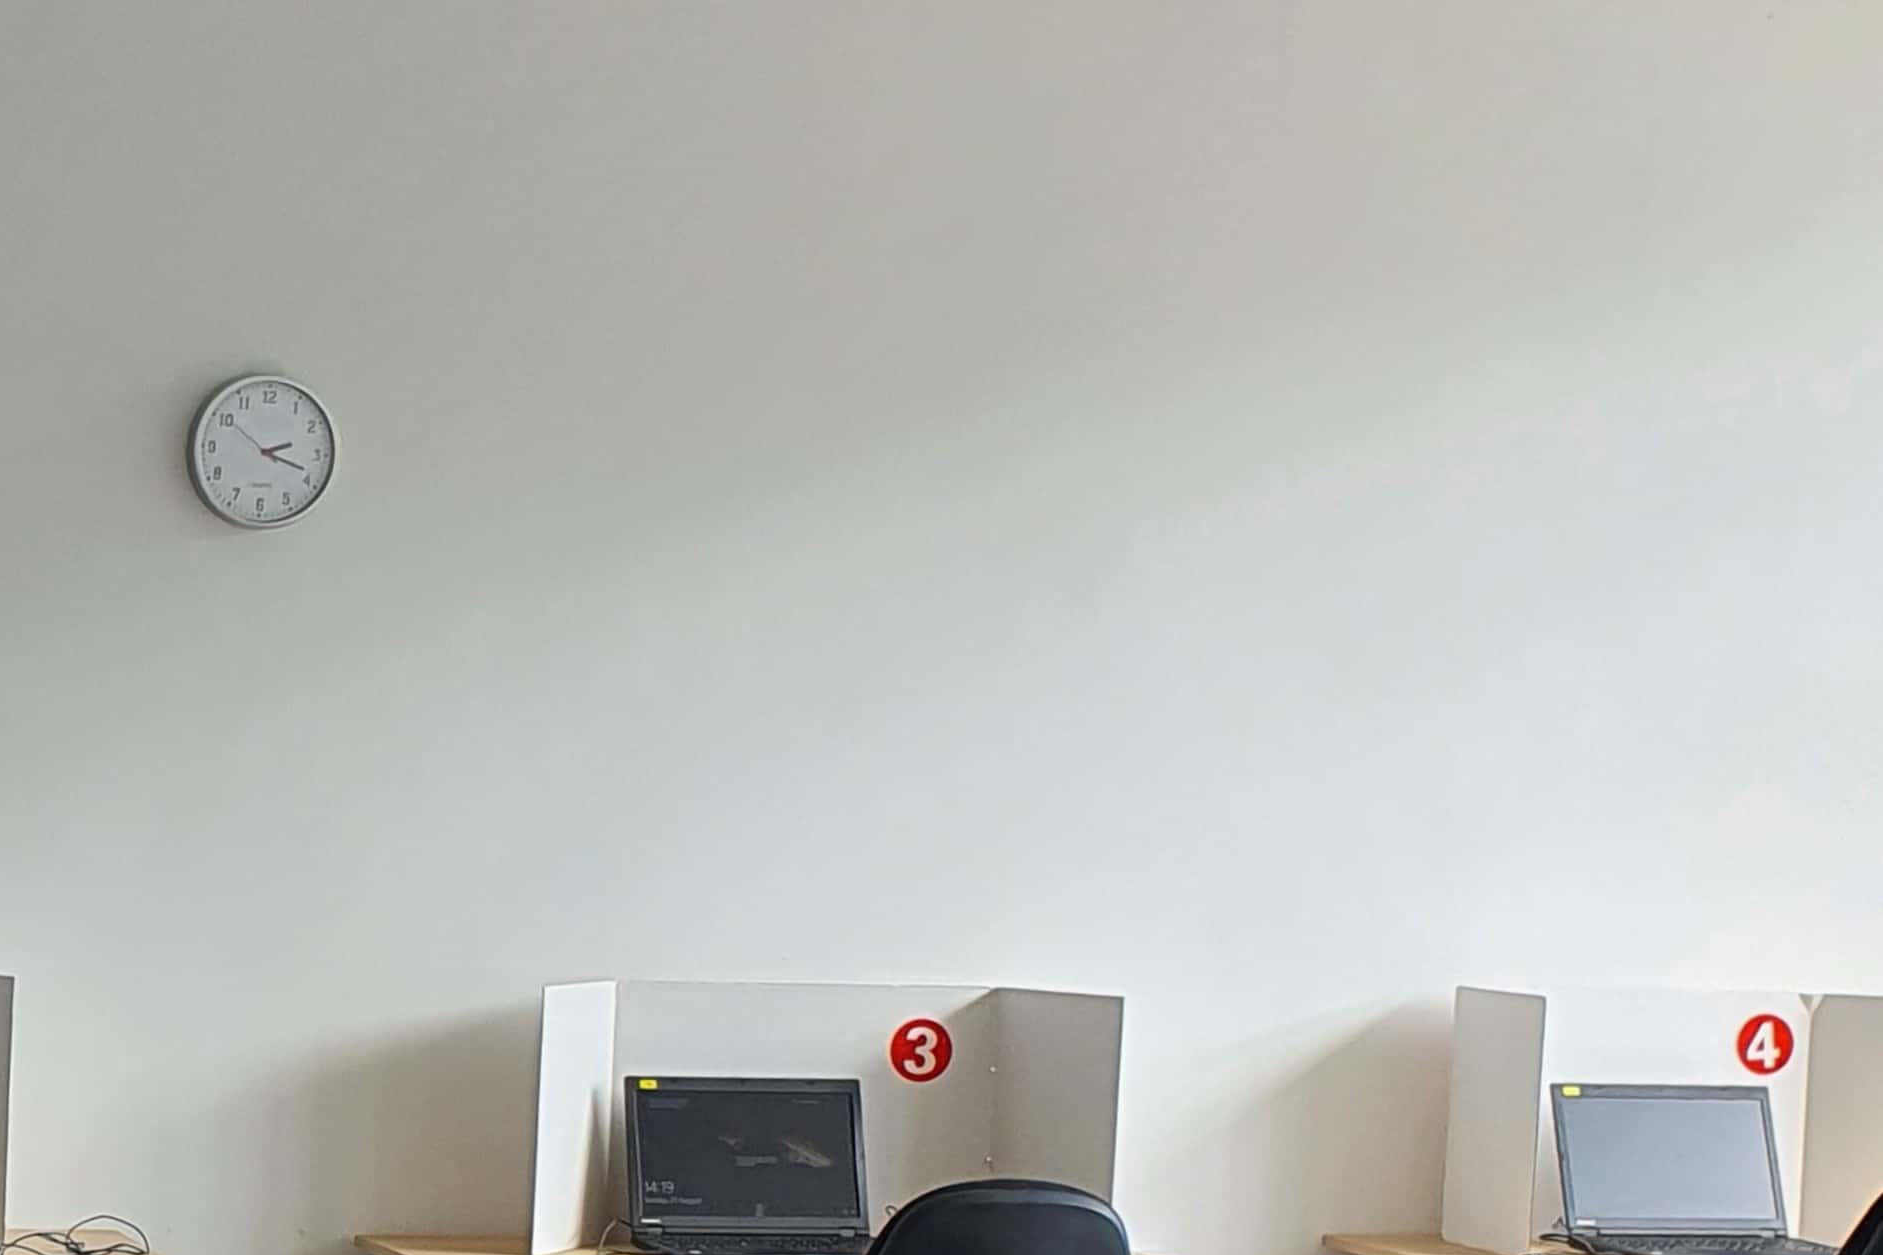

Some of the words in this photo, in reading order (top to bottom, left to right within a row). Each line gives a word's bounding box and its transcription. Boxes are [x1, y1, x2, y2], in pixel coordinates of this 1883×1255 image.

[239, 397, 250, 410] 11
[262, 390, 277, 404] 12
[293, 401, 299, 415] 1
[219, 413, 234, 427] 10
[307, 420, 316, 433] 2
[213, 466, 221, 479] 8
[232, 487, 241, 501] 7
[282, 492, 290, 505] 5
[256, 497, 264, 511] 6
[902, 1026, 938, 1076] 3
[1747, 1020, 1781, 1069] 4
